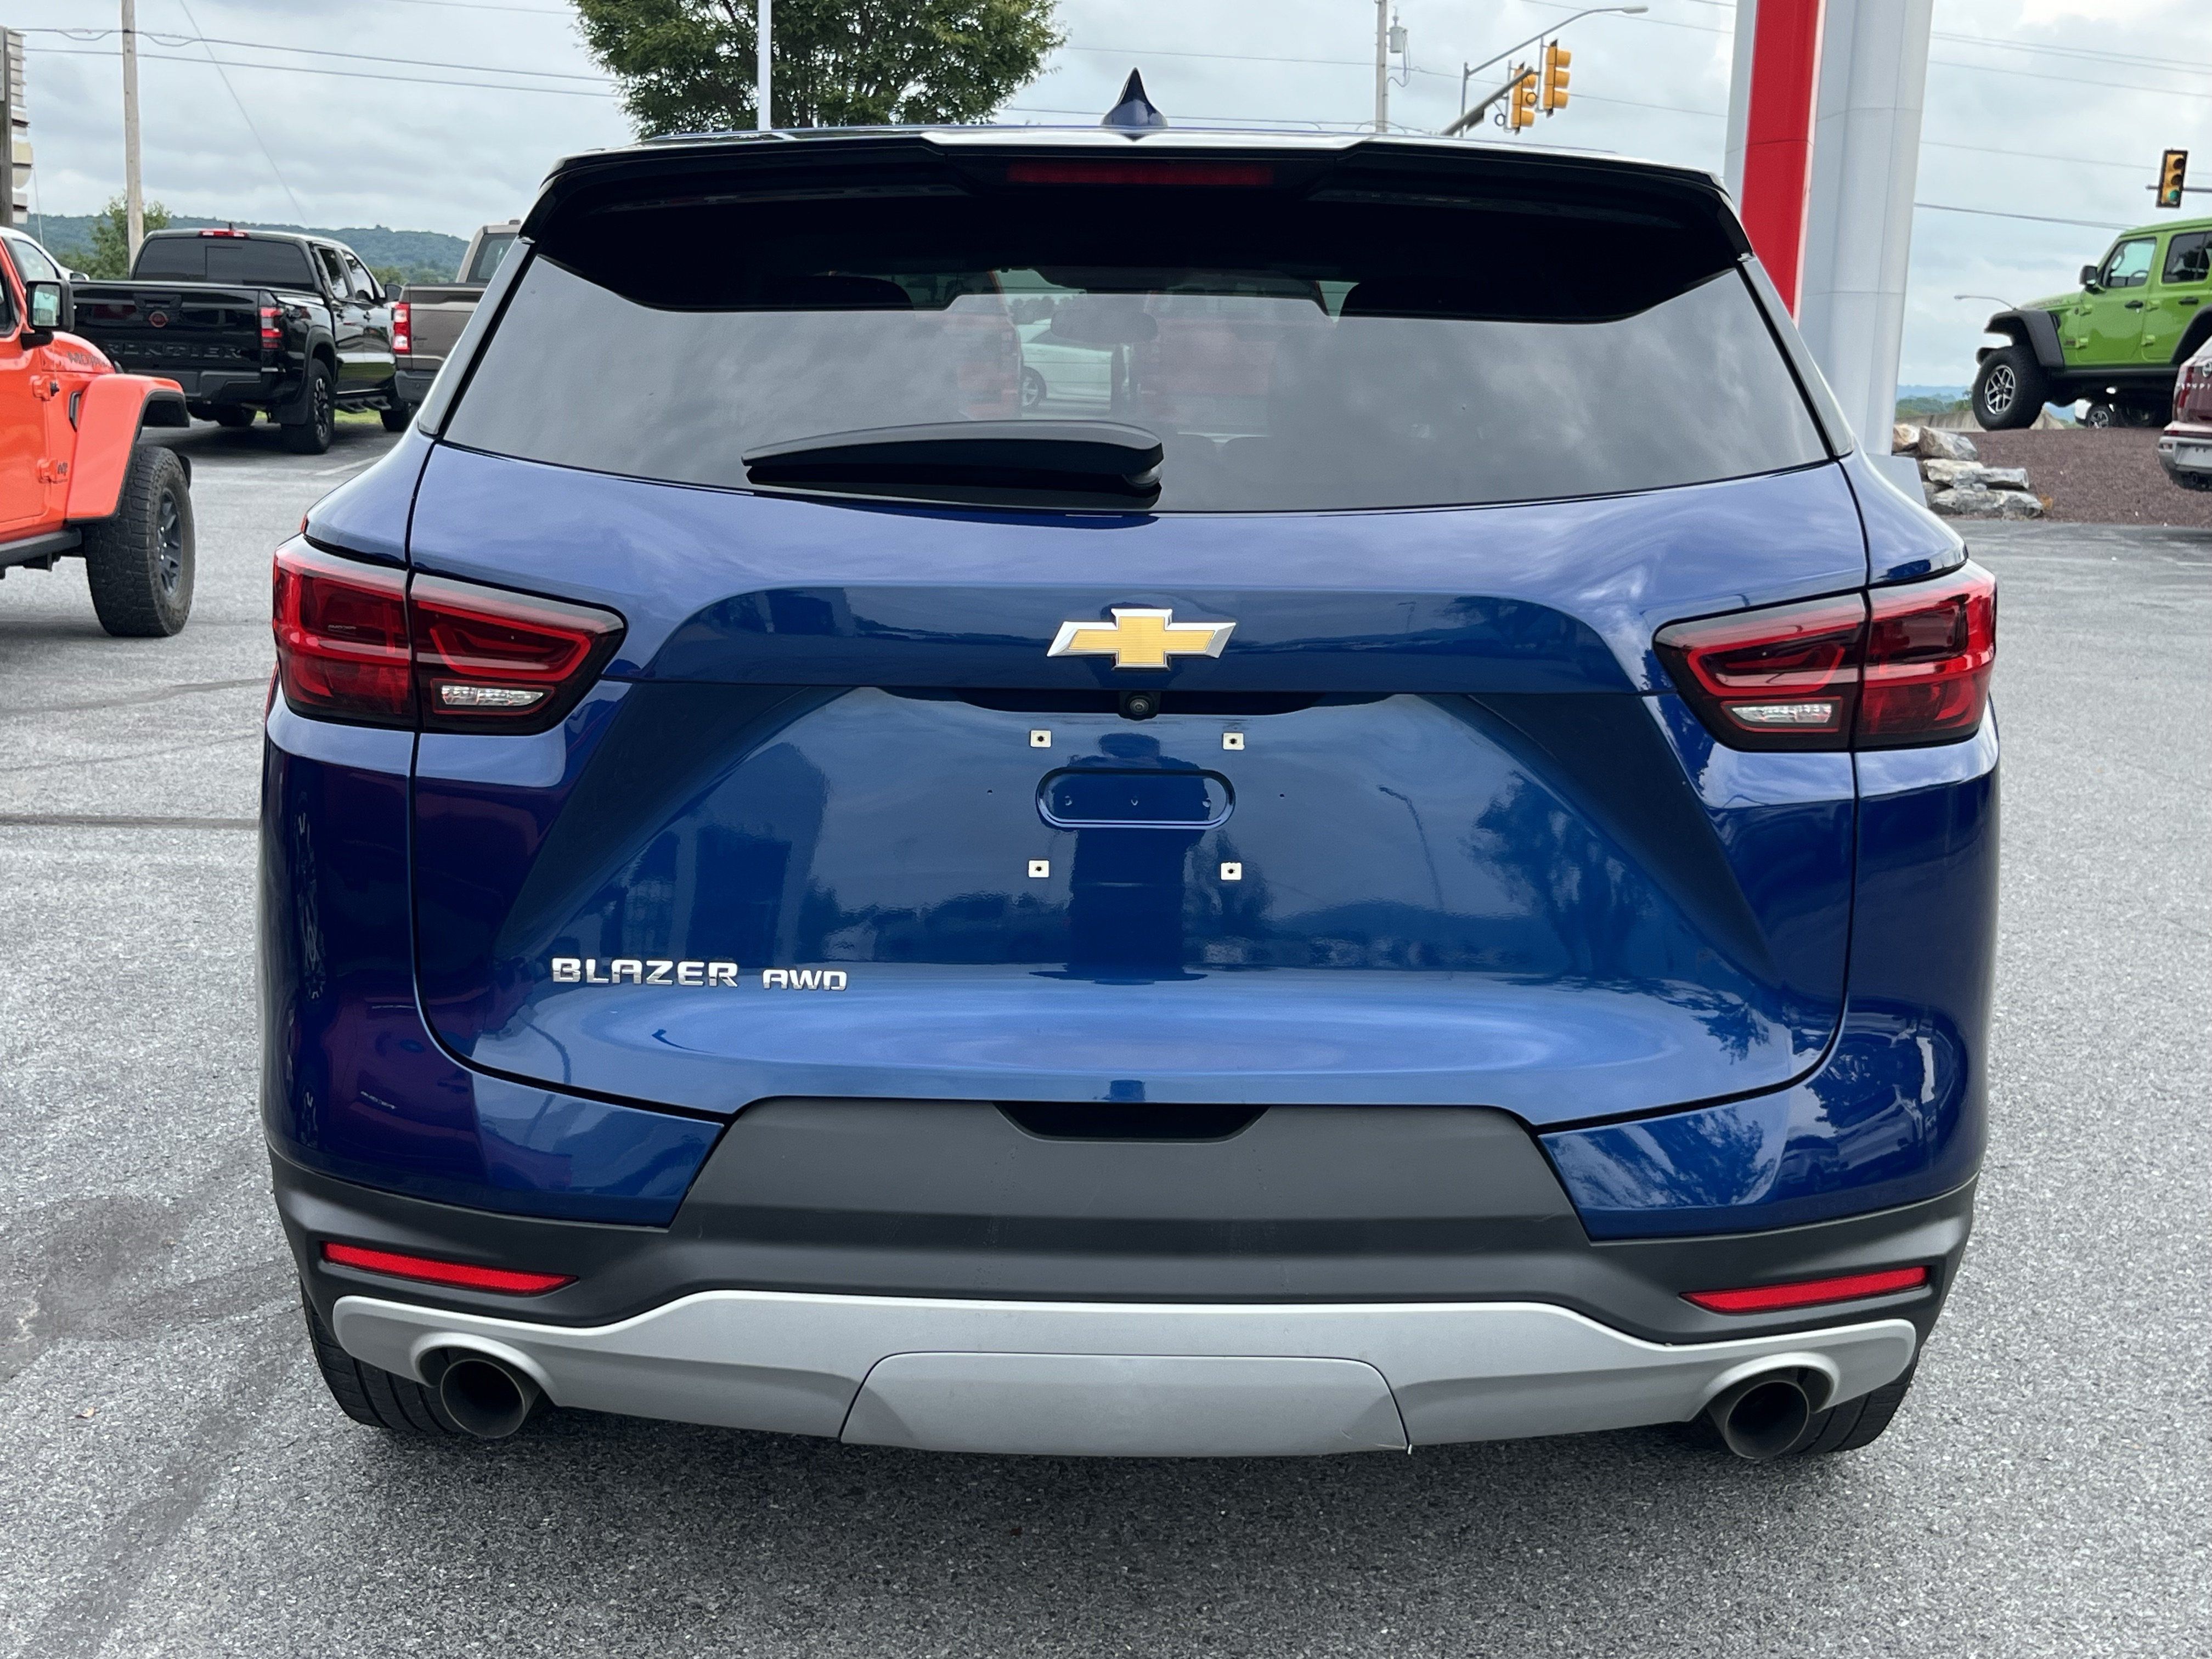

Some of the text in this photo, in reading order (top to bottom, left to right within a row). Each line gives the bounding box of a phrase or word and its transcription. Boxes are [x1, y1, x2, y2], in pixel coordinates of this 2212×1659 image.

[103, 342, 242, 358] RONTIER
[551, 957, 848, 990] BLAZER AWD
